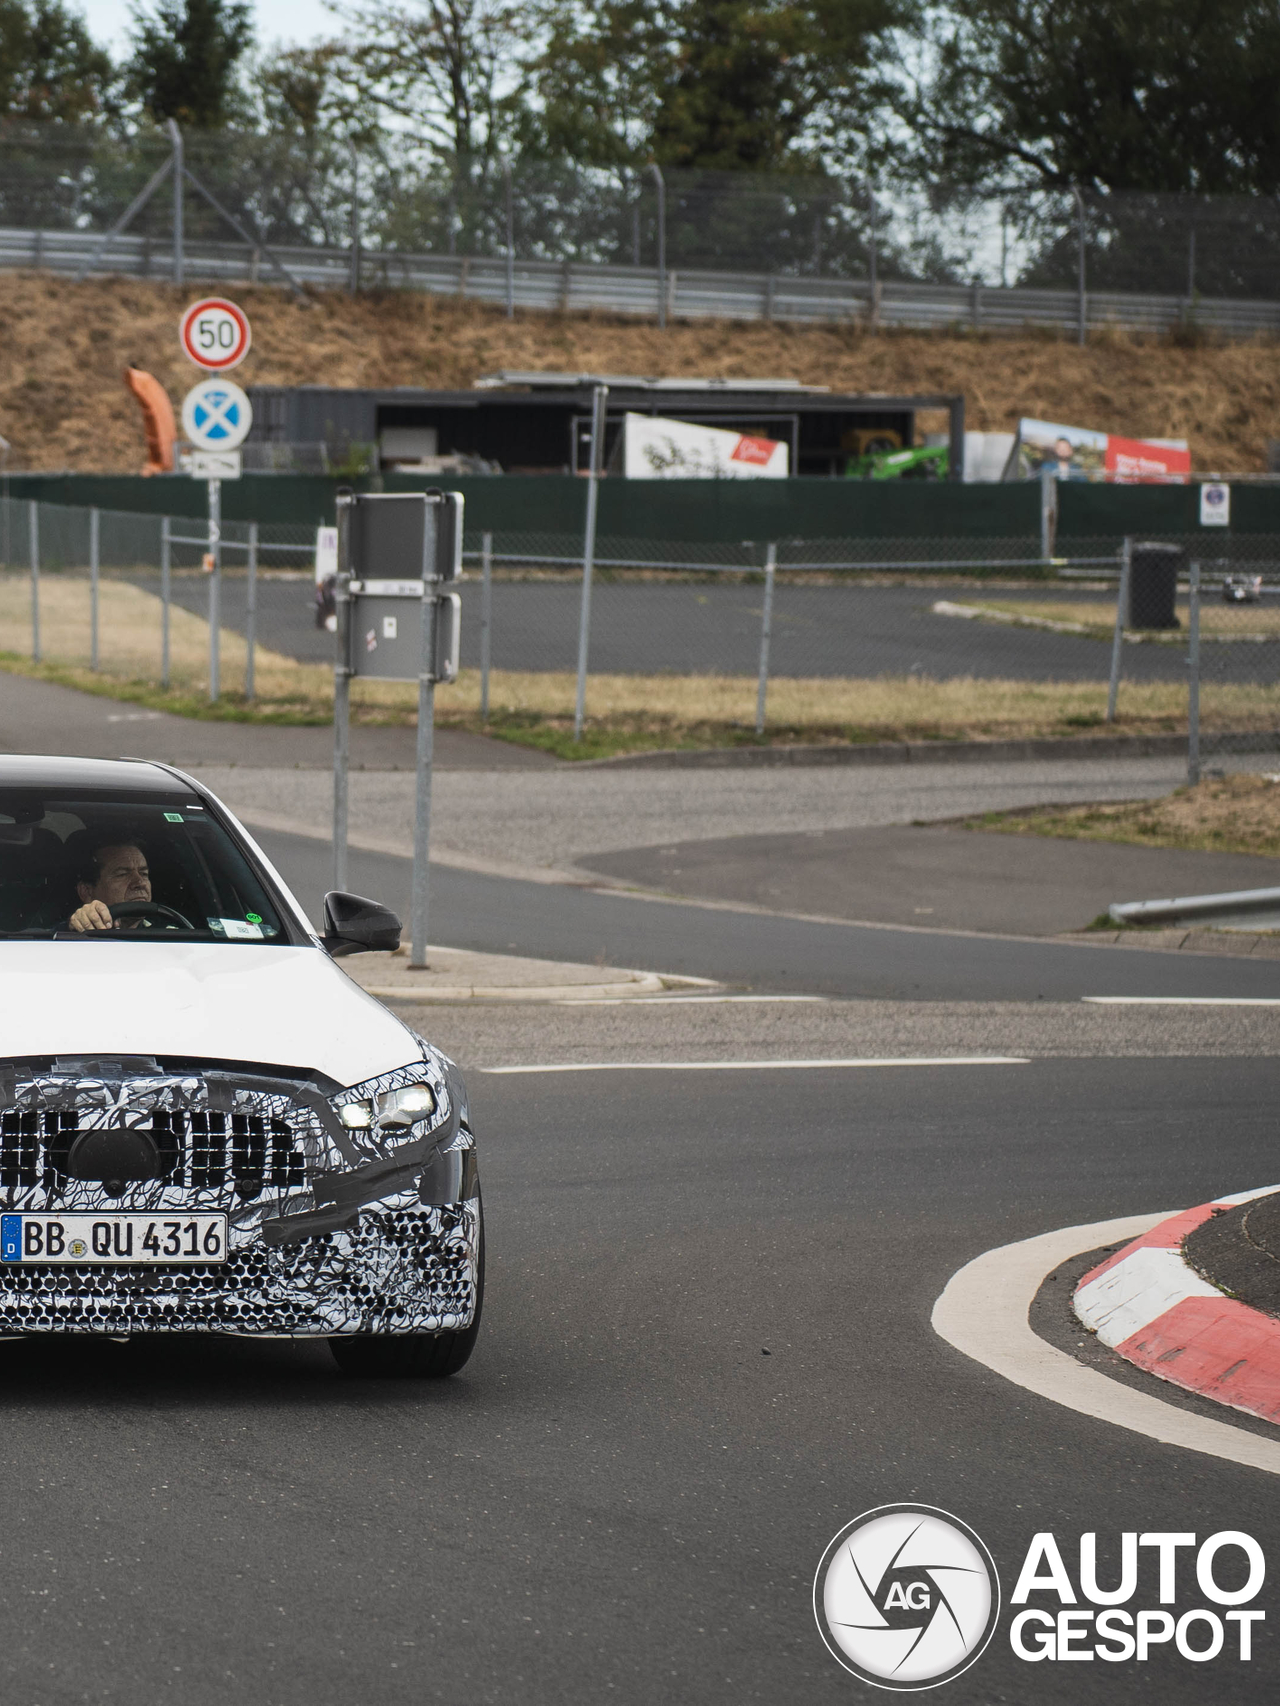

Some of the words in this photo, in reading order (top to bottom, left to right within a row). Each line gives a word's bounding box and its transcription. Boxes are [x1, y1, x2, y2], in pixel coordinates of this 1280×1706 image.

[199, 320, 234, 348] 50
[7, 1243, 15, 1254] D
[24, 1221, 65, 1256] BB
[92, 1221, 133, 1257] QU
[142, 1221, 221, 1257] 4316
